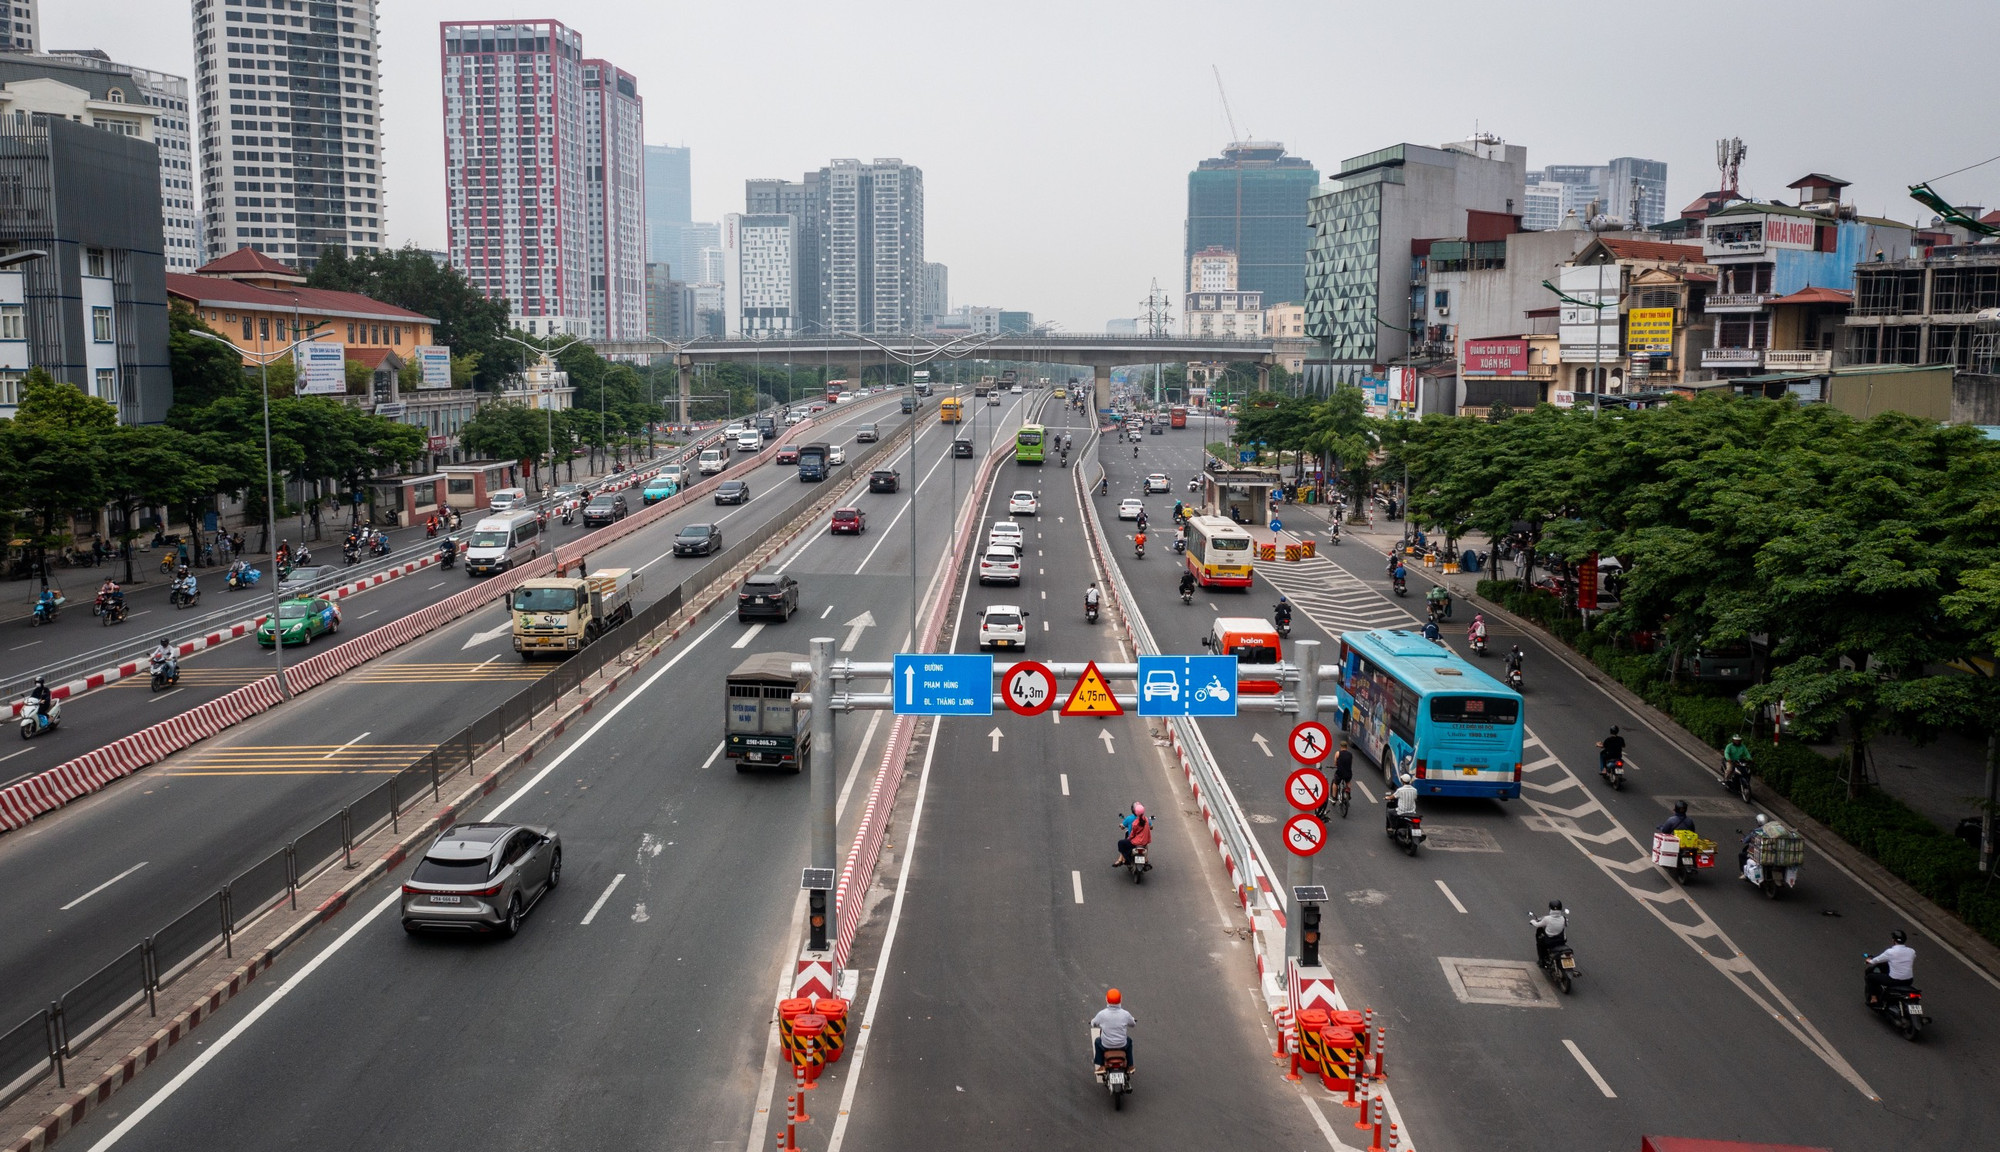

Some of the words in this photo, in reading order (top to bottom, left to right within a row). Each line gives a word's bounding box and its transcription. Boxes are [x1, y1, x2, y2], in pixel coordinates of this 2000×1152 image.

[1768, 217, 1787, 243] NHÀ
[1789, 217, 1813, 245] NGHỈ
[1470, 344, 1486, 355] QUẢNG
[1506, 344, 1521, 356] THUẬT
[1481, 356, 1497, 369] XUÂN
[1499, 356, 1511, 368] HẢI
[544, 615, 560, 625] Sky
[924, 662, 944, 671] ĐƯỜNG
[924, 681, 940, 690] PHẠM
[944, 680, 958, 688] HÙNG
[937, 697, 955, 705] THĂNG
